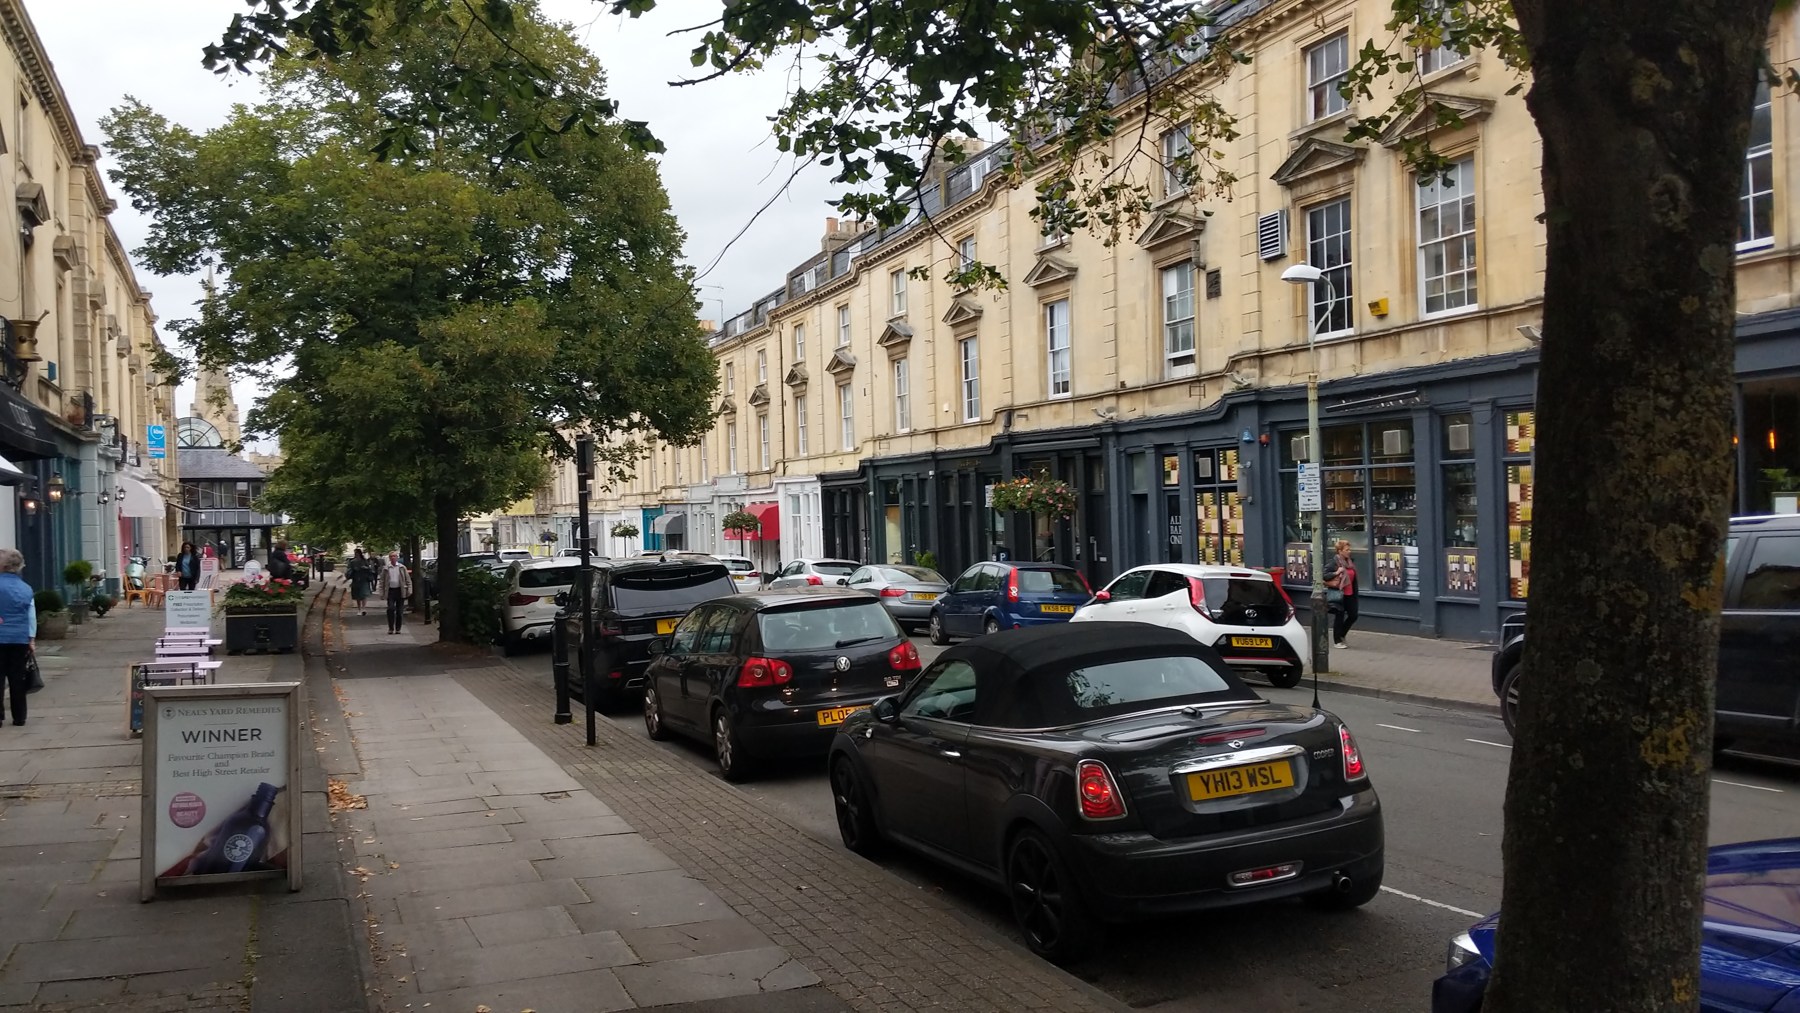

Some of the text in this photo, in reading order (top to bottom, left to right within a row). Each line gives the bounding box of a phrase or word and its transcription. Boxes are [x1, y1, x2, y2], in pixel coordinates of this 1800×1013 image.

[1255, 638, 1270, 646] LPX
[209, 707, 234, 716] YARD
[235, 706, 282, 715] REMEDIES
[181, 728, 262, 744] WINNER
[168, 749, 275, 762] Favourite Champion Brand
[214, 760, 229, 768] and
[172, 766, 270, 778] Best High Street Retailer
[1200, 765, 1282, 794] YH13 WSL
